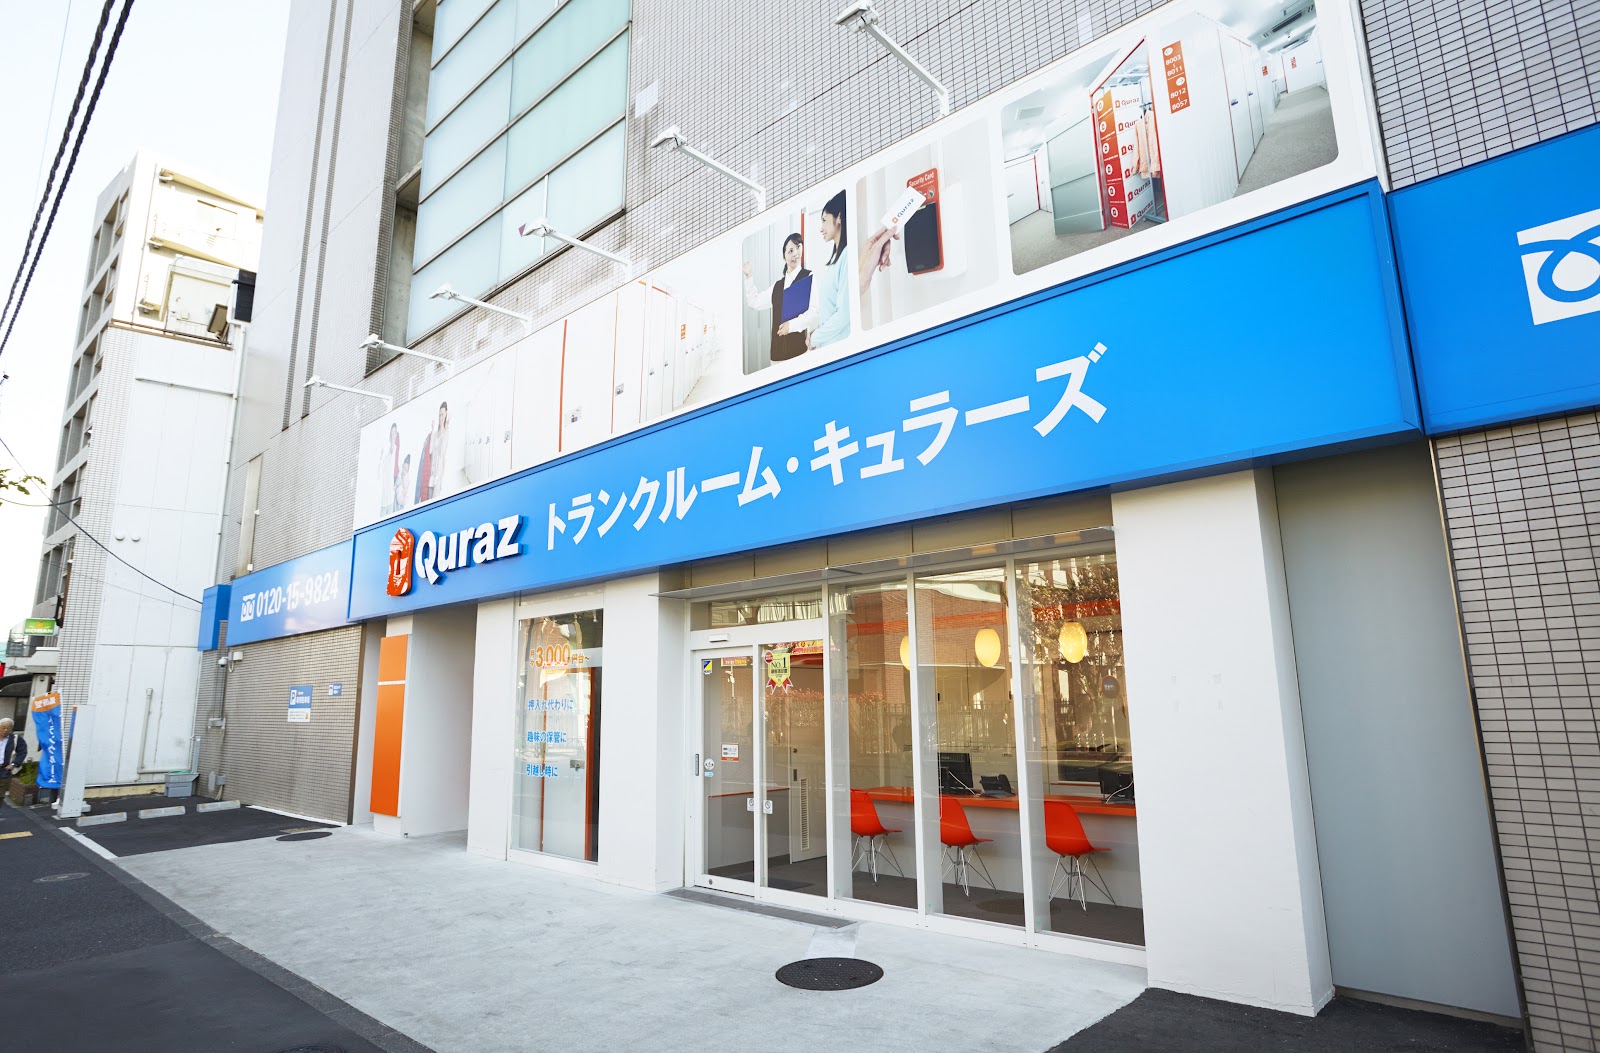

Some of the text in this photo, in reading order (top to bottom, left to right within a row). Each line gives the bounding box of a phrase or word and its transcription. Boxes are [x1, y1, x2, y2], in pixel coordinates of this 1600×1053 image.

[1167, 66, 1183, 76] 8011
[1170, 88, 1186, 98] 8012
[1121, 97, 1139, 106] Quraz
[1172, 99, 1188, 110] 8057
[1124, 119, 1138, 128] Qur
[909, 176, 925, 187] Security
[925, 171, 935, 181] Card
[897, 198, 915, 218] Quraz
[415, 514, 523, 585] Quraz
[256, 570, 339, 618] 0120-15-9824
[528, 698, 575, 711] 押入れ代わりに
[527, 731, 567, 743] 趣味の保管に
[526, 763, 558, 777] 引越し時に
